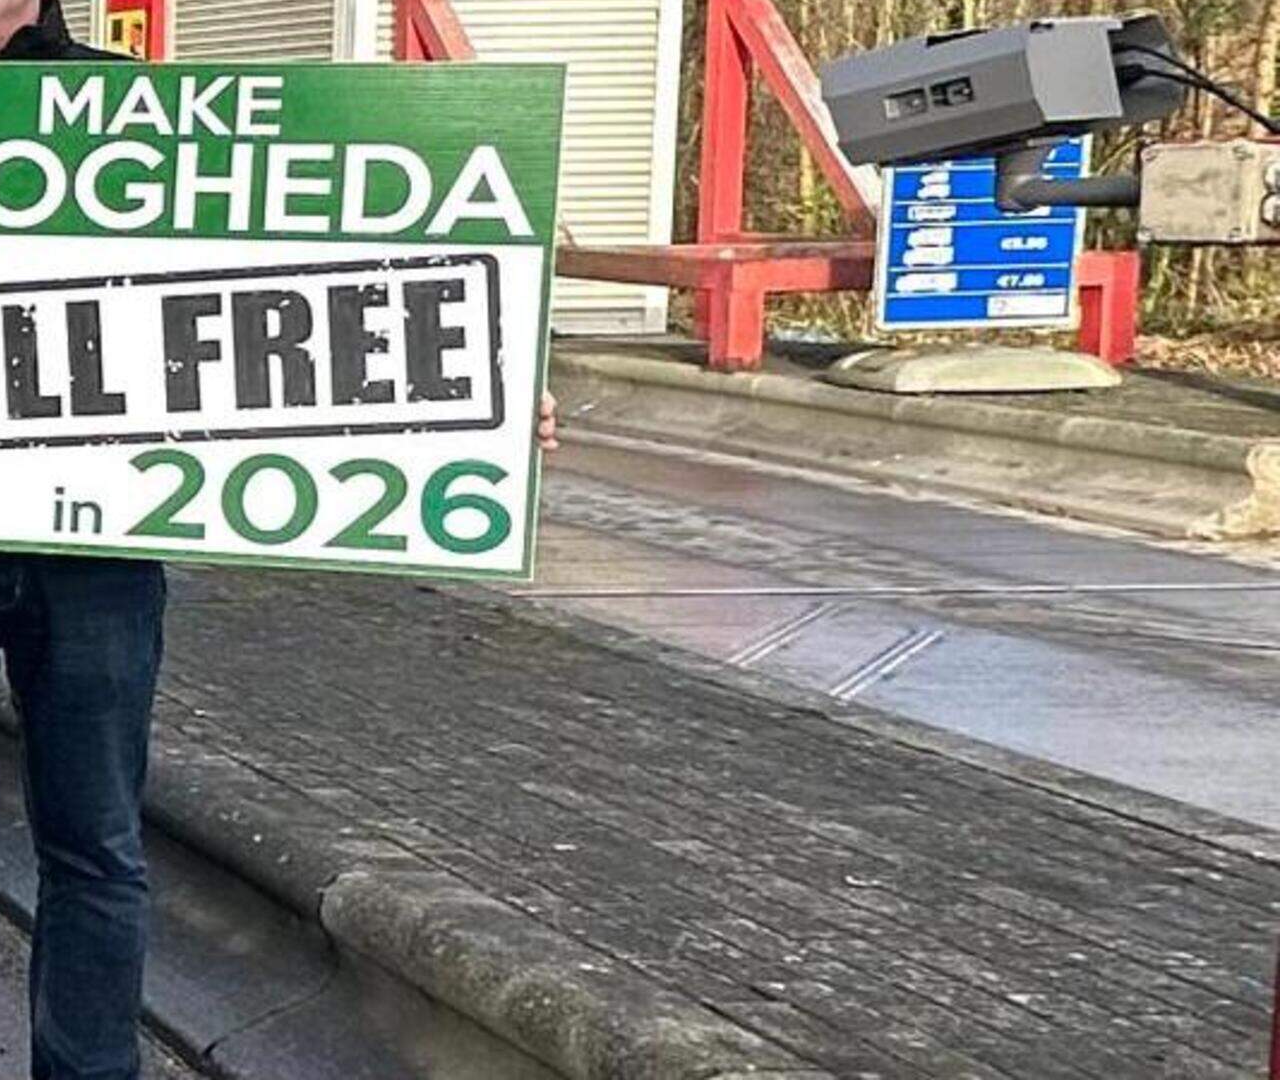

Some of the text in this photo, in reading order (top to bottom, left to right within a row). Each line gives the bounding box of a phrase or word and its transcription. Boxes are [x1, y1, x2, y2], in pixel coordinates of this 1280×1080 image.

[38, 74, 284, 137] MAKE
[161, 277, 474, 414] FREE
[53, 448, 513, 555] in 2026
